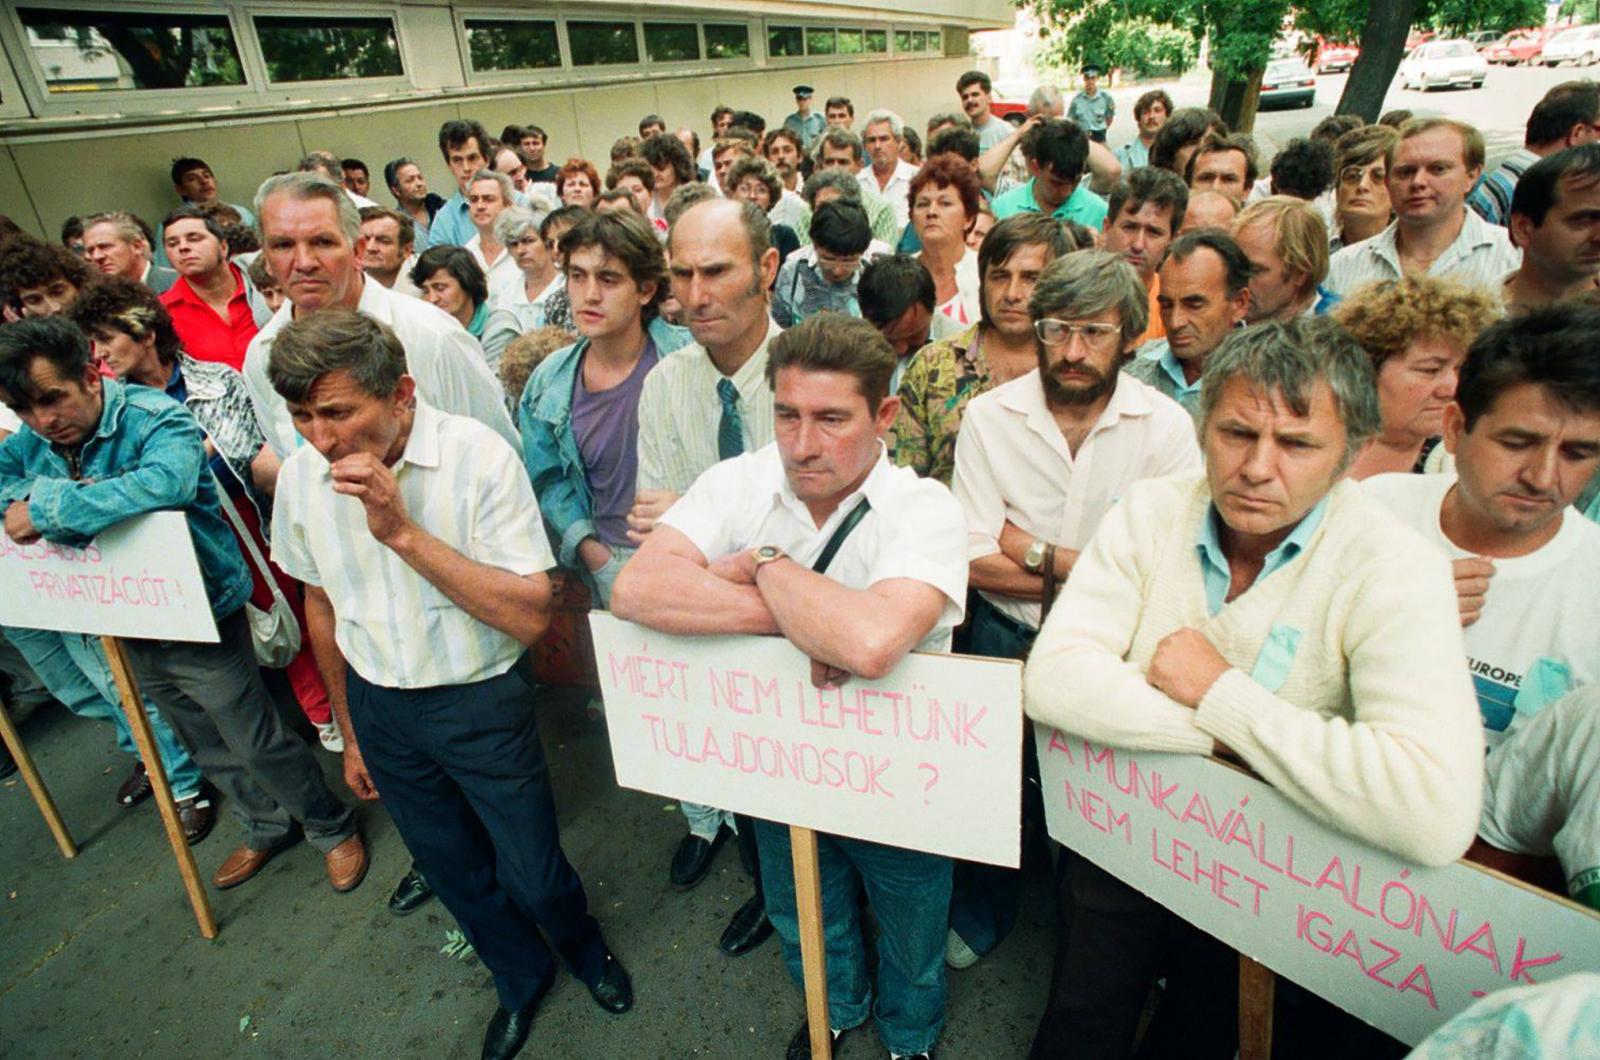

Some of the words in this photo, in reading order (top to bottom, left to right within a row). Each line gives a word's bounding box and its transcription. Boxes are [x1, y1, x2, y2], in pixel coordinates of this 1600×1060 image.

[607, 643, 689, 701] MIÉRT
[708, 667, 783, 717] NEM
[798, 681, 989, 749] LEHETÜNK
[1466, 655, 1523, 688] UROPE
[641, 713, 896, 798] TULAJDONOSOK
[1047, 727, 1075, 765] A
[1083, 737, 1563, 985] MUNKAVÁLLALÓNAK
[1064, 780, 1132, 845] NEM
[1152, 827, 1270, 917] LEHET
[1297, 903, 1438, 1010] IGAZA
